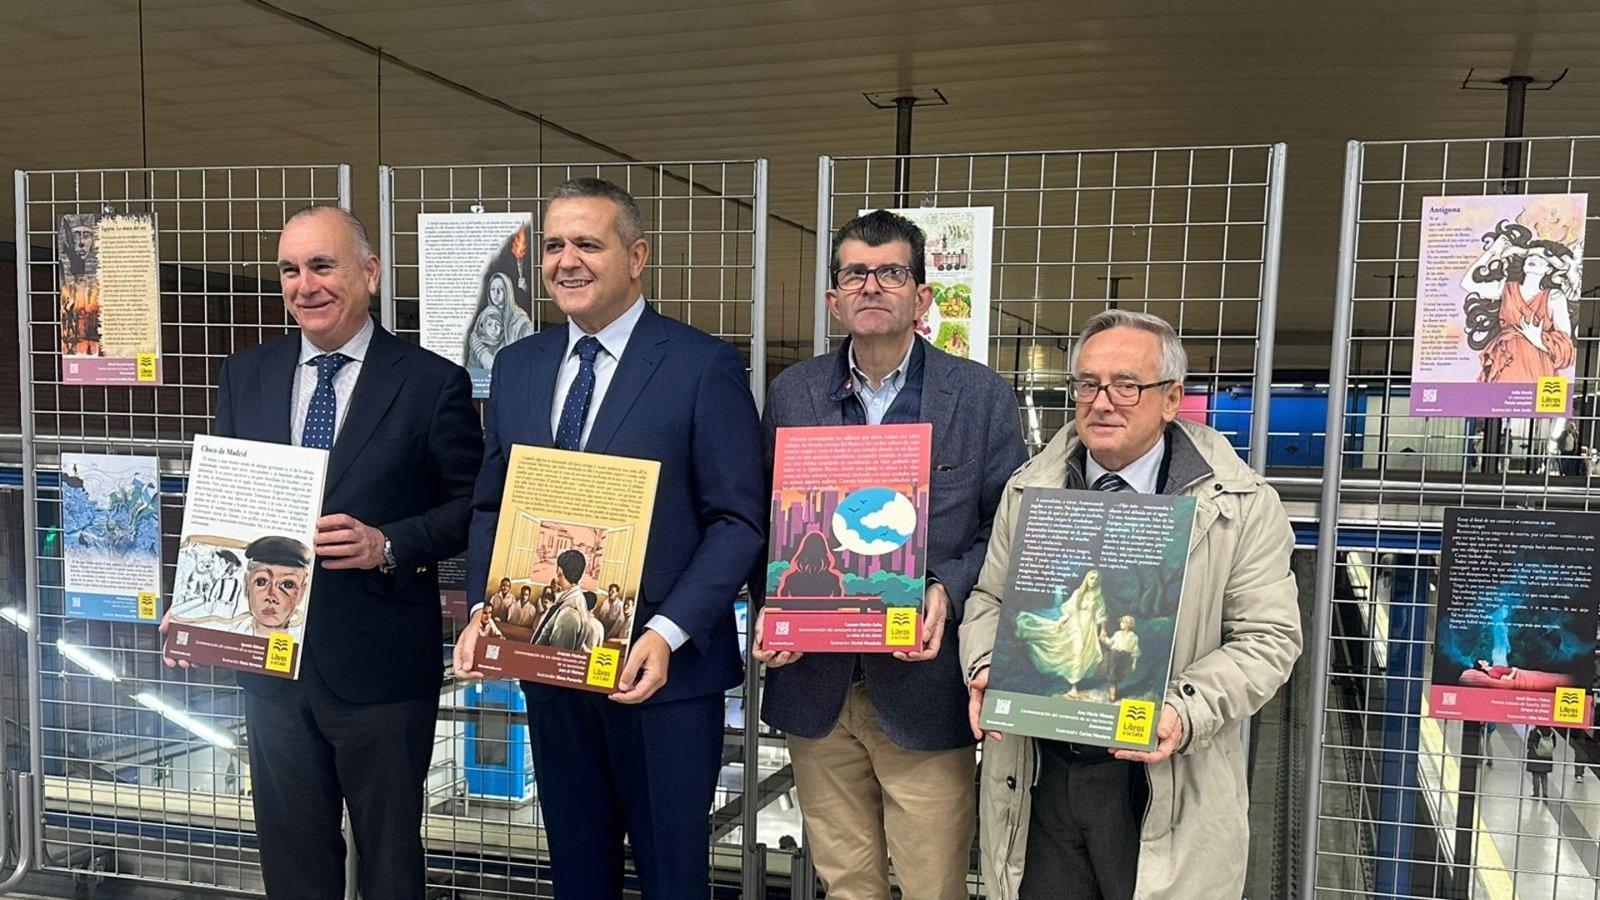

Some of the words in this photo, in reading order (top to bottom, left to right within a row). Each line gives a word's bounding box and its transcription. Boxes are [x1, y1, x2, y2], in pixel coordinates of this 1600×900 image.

[226, 448, 247, 457] Madrid
[271, 653, 287, 661] Libros
[594, 668, 610, 677] Libros
[1123, 724, 1144, 733] Libros
